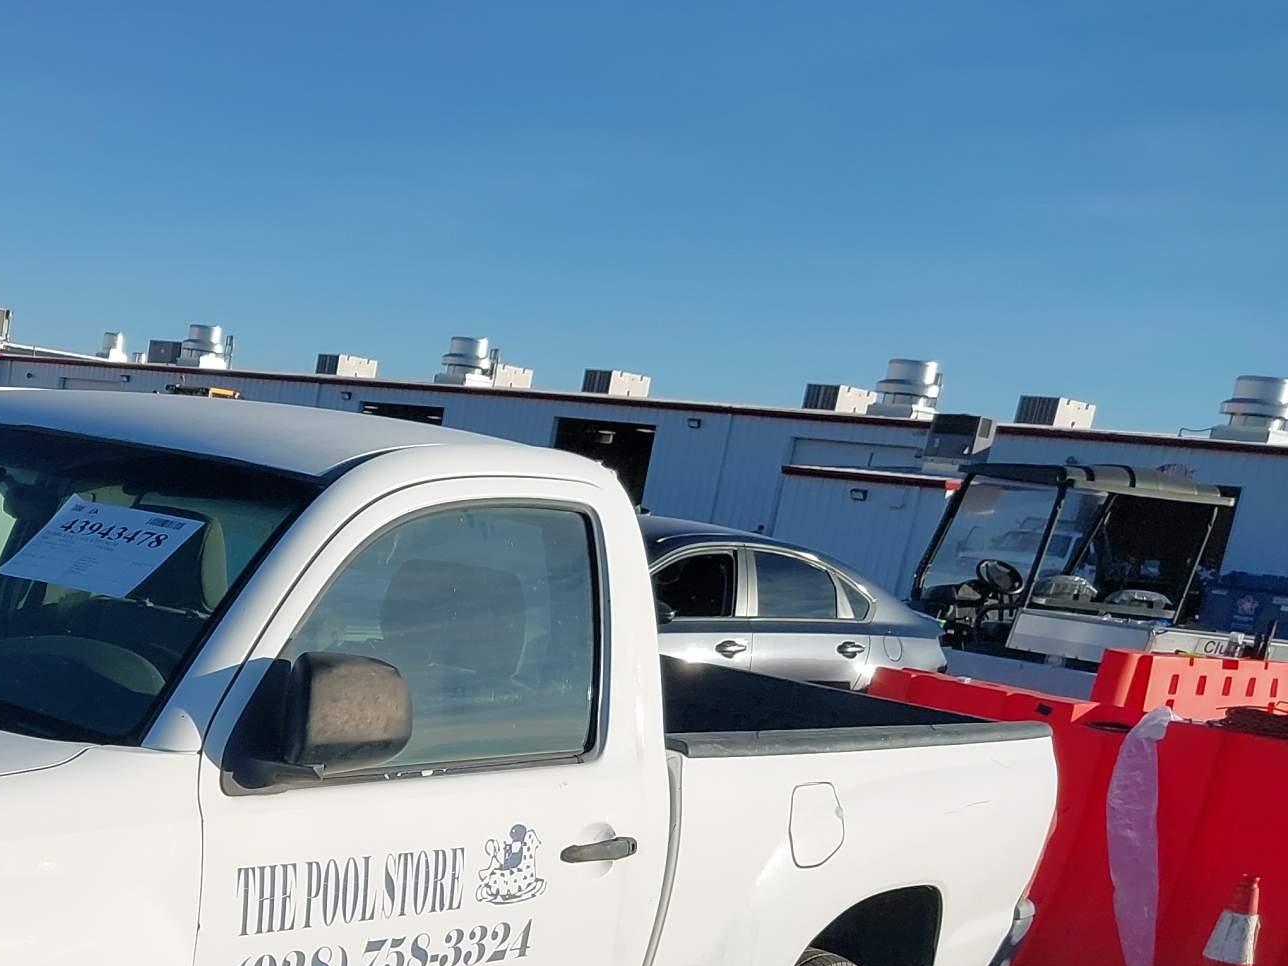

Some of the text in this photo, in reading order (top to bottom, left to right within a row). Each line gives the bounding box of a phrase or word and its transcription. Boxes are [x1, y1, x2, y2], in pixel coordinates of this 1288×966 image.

[60, 519, 169, 548] 43943478
[236, 847, 464, 936] THE POOL STORE
